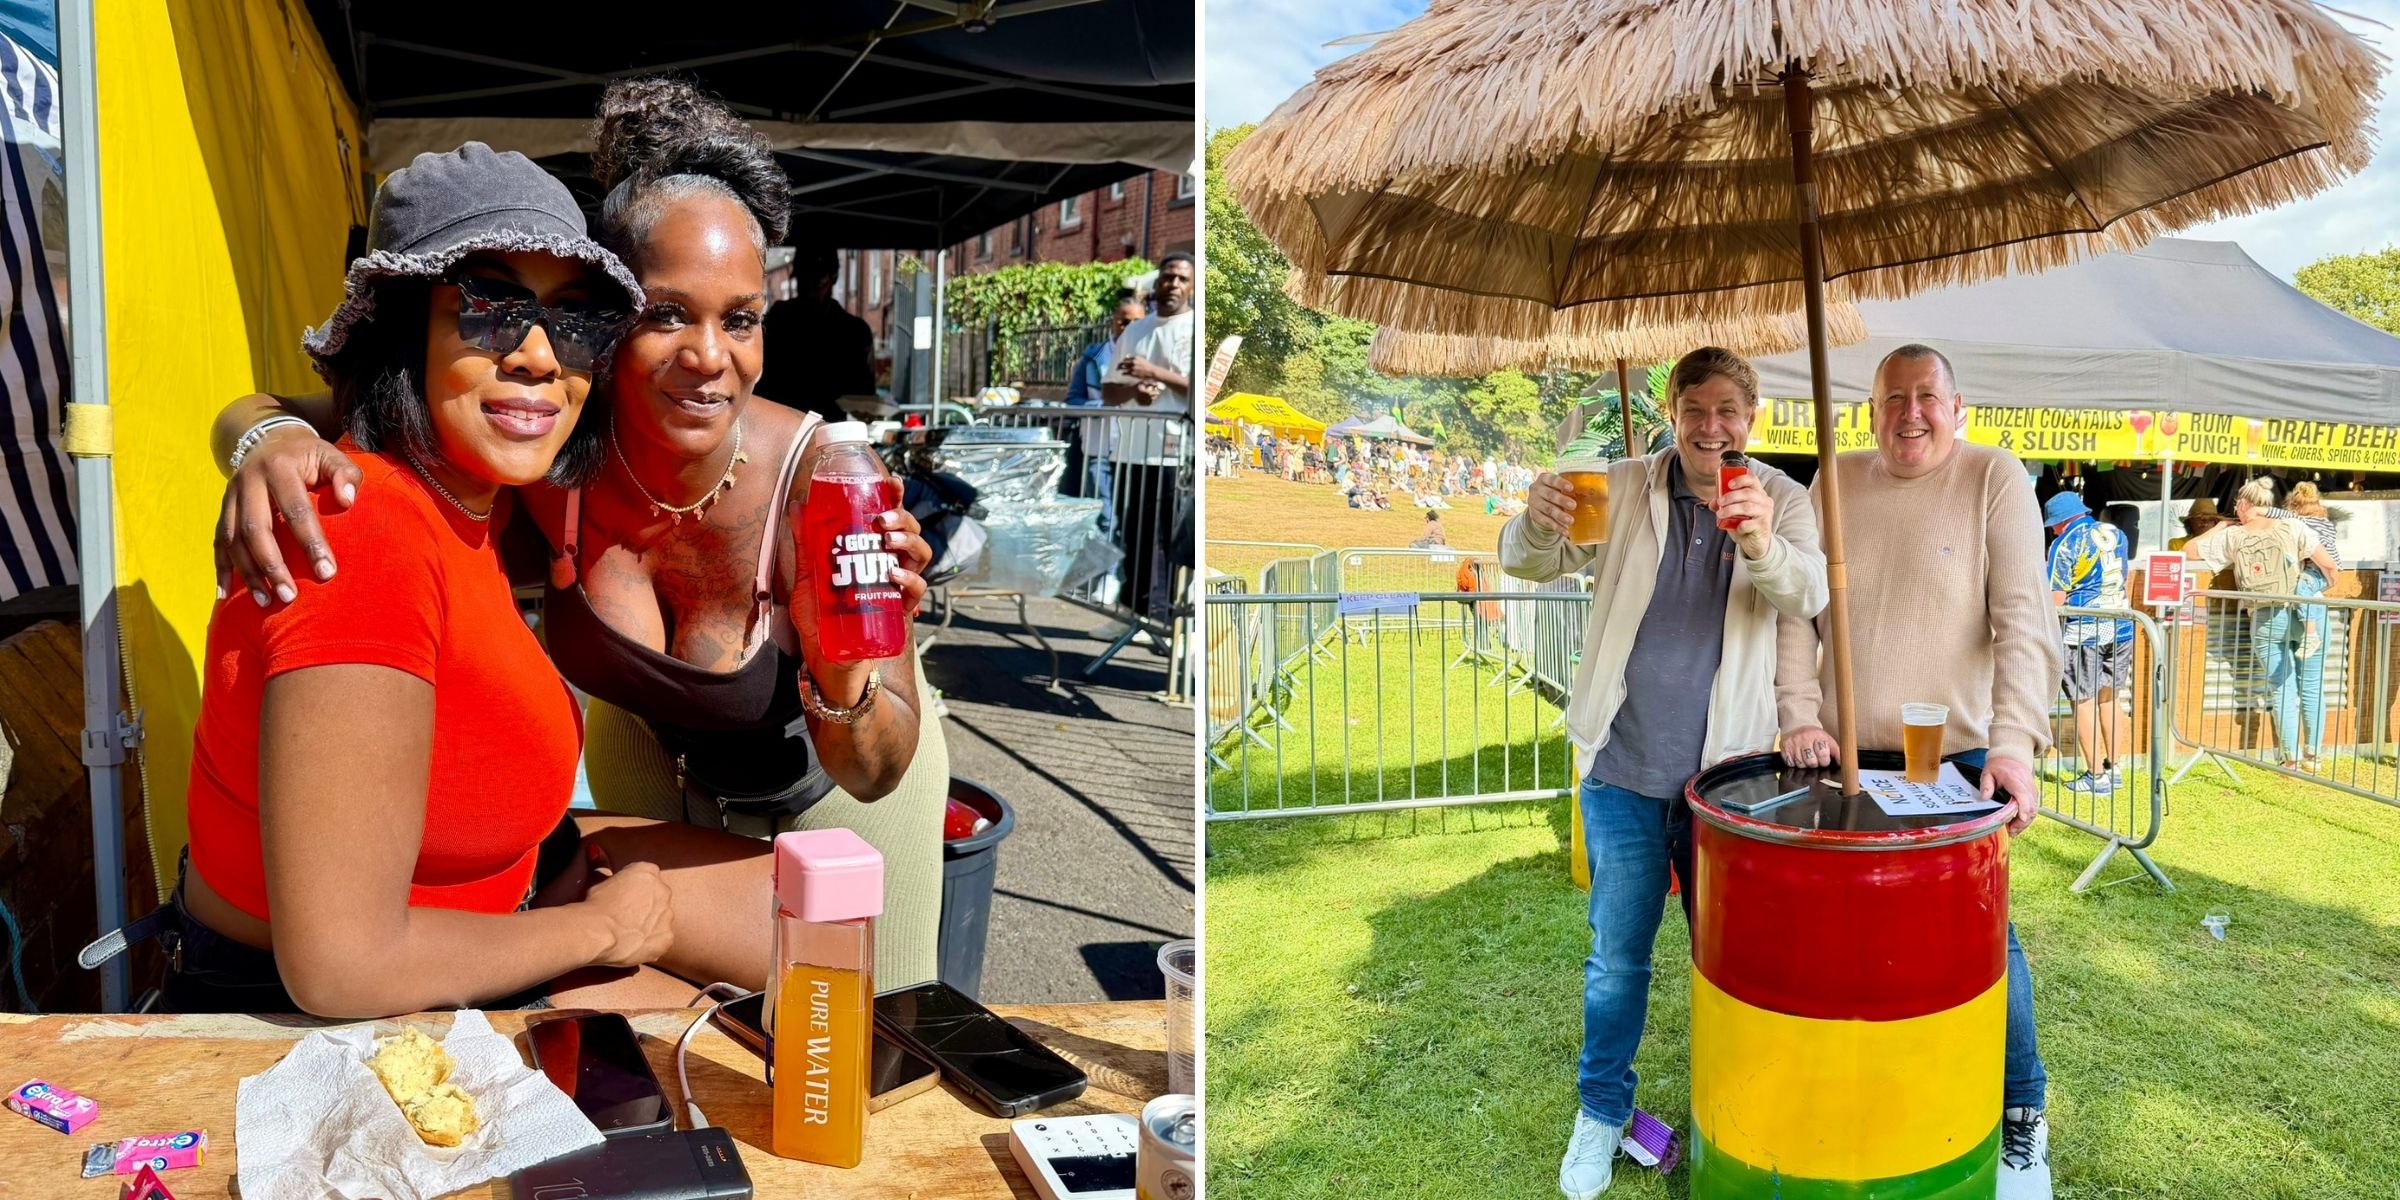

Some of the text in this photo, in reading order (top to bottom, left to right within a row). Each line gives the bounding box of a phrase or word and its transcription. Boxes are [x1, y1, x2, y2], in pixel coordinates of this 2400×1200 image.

[1213, 351, 1232, 380] BEAT
[1772, 400, 1863, 428] DRFT
[1975, 406, 2123, 430] FROZEN COCKTAILS
[2190, 412, 2233, 434] RUM
[1767, 429, 1802, 447] WINE,
[1998, 430, 2097, 451] & SLUSH
[2177, 433, 2240, 455] PUNCH
[2267, 419, 2398, 449] DRAFT BEER
[2262, 444, 2396, 465] WINE, CIDERS, SPIRITS & CANS
[845, 533, 882, 552] GOT
[855, 592, 882, 601] FRUIT
[1346, 594, 1374, 603] KEEP
[1871, 778, 1910, 805] NOTICE
[804, 979, 831, 1125] PURE WATER
[26, 1084, 63, 1105] extra
[138, 1133, 194, 1149] extra
